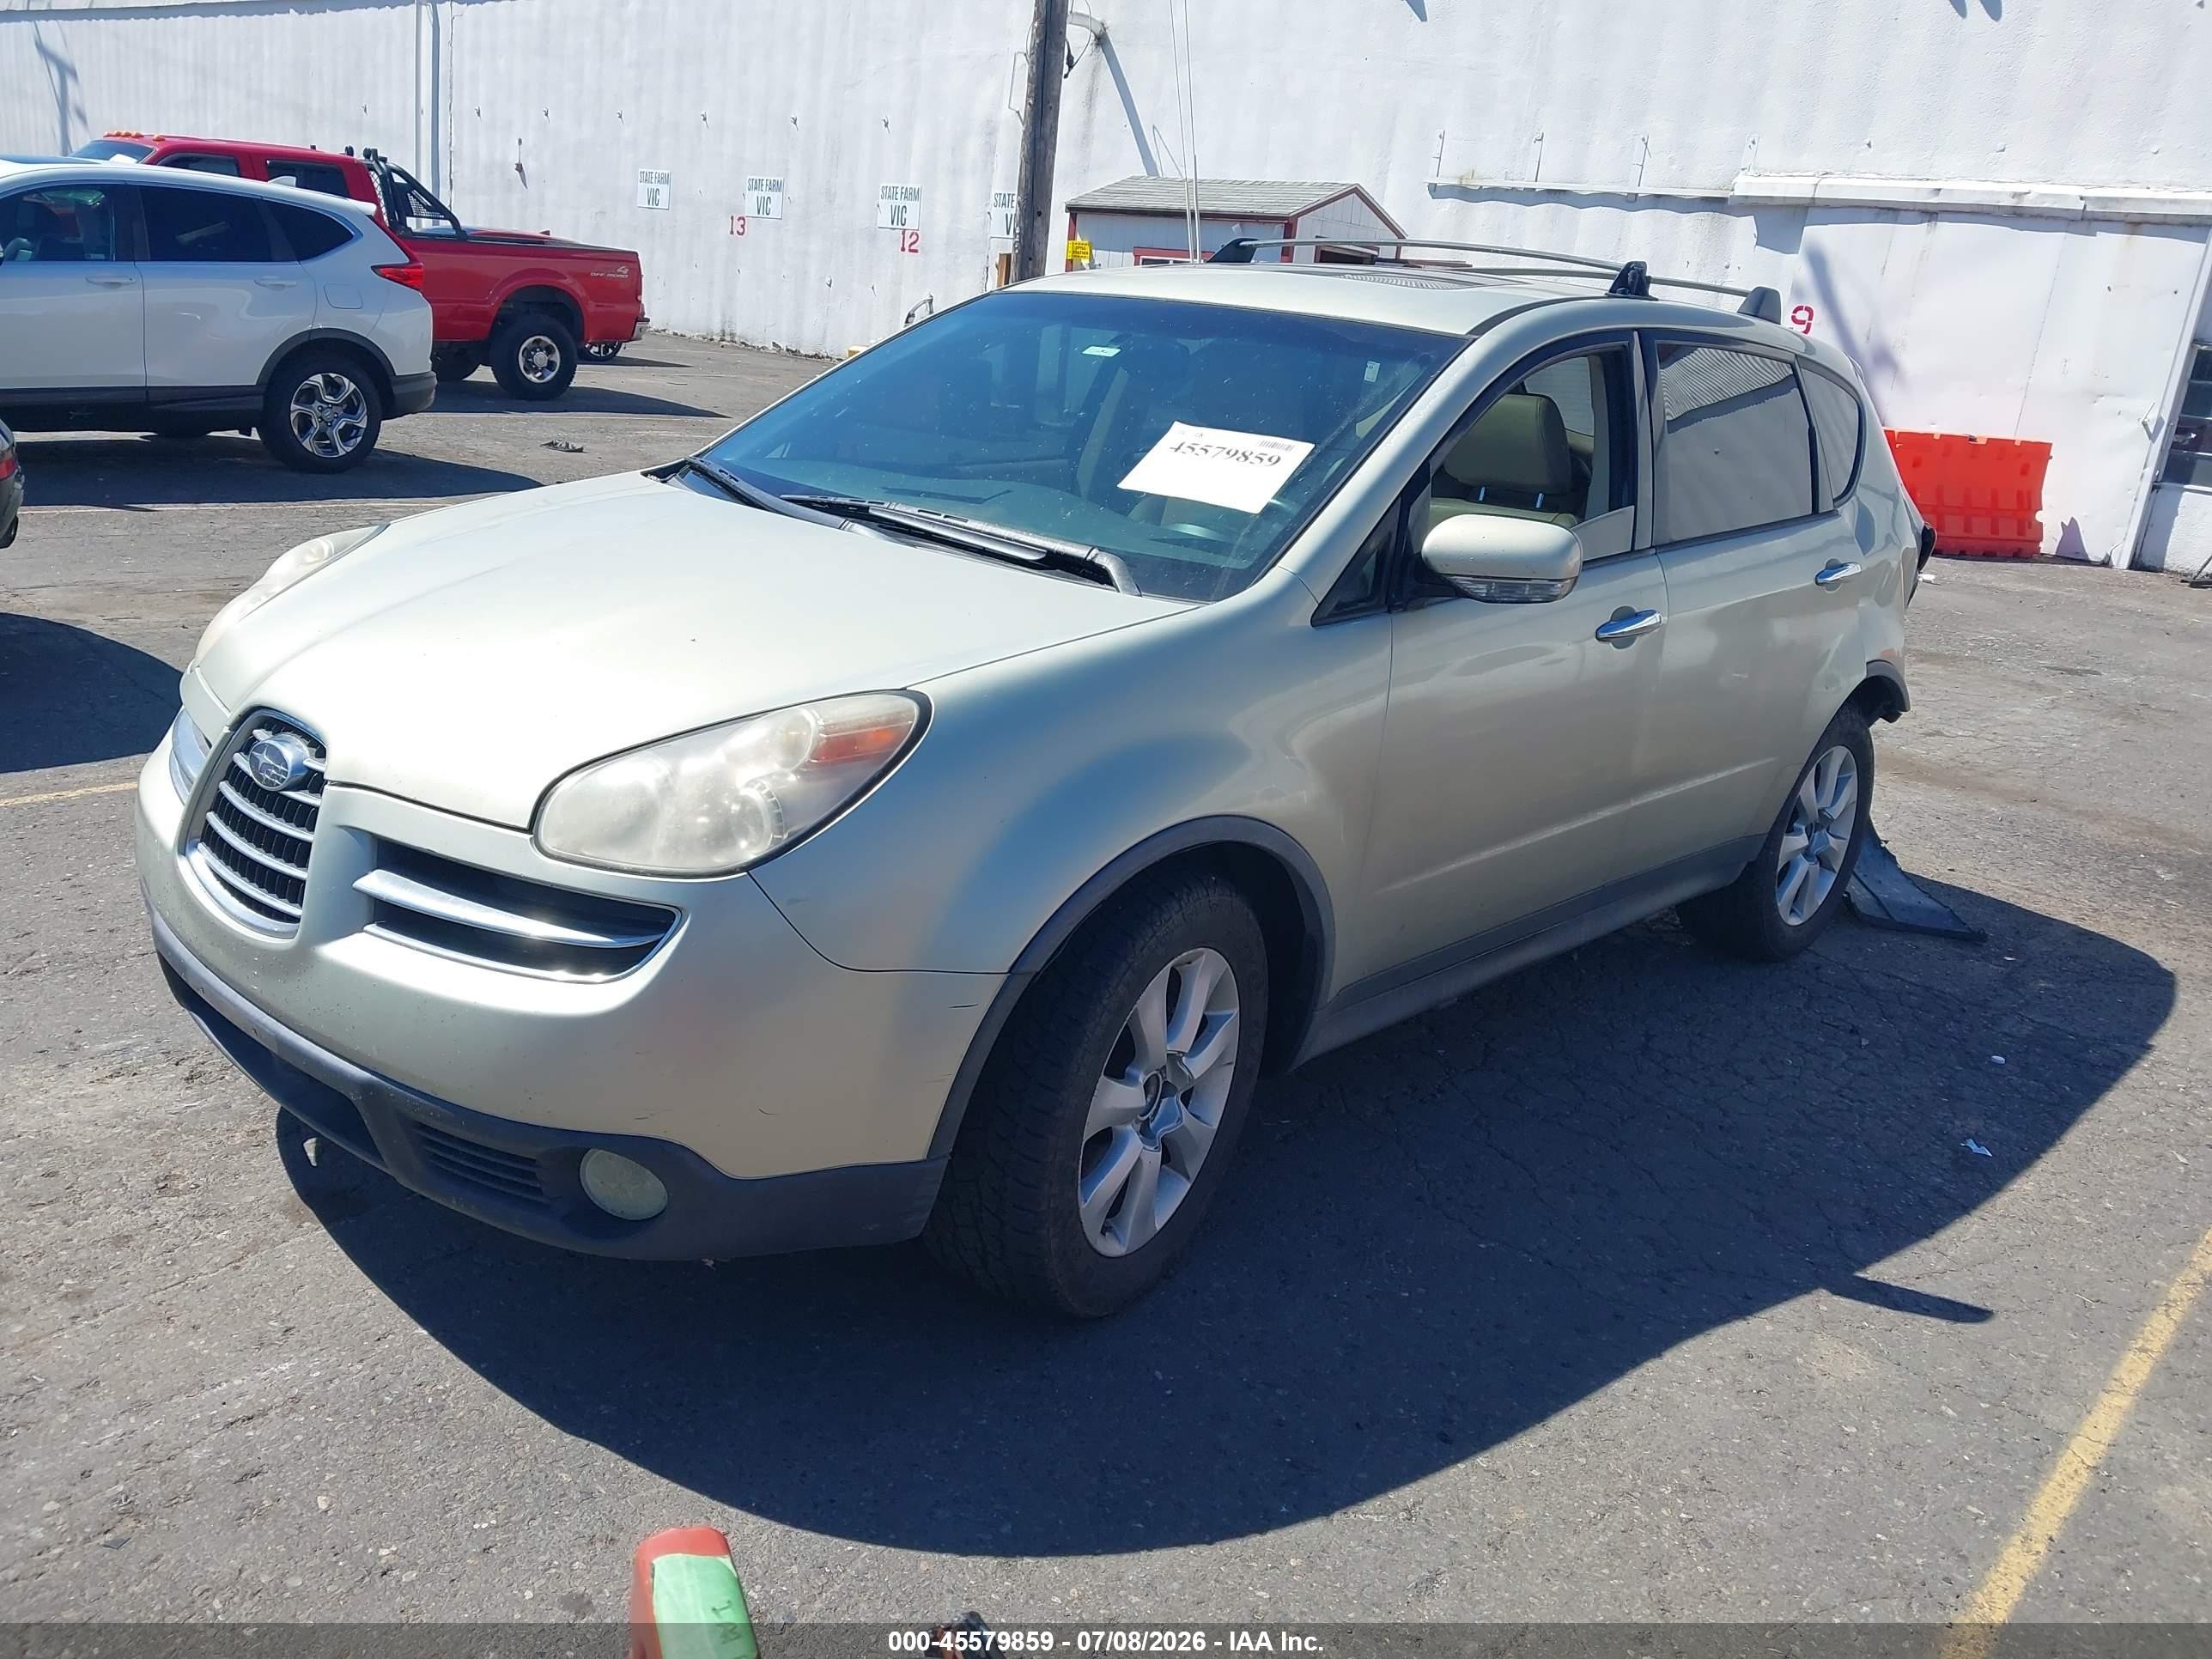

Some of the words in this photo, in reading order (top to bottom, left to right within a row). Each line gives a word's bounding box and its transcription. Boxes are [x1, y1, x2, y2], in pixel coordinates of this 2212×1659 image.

[639, 170, 653, 184] STATE
[654, 171, 670, 185] FARM
[747, 178, 764, 191] STATE
[765, 179, 782, 193] FARM
[647, 187, 660, 207] VIC
[880, 185, 899, 201] STATE
[900, 185, 920, 202] FARM
[994, 192, 1016, 209] STATE
[757, 195, 772, 216] VIC
[890, 204, 907, 226] VIC
[729, 215, 746, 236] 13
[900, 229, 920, 253] 12
[1790, 305, 1814, 335] 9
[1169, 441, 1282, 467] 45579859
